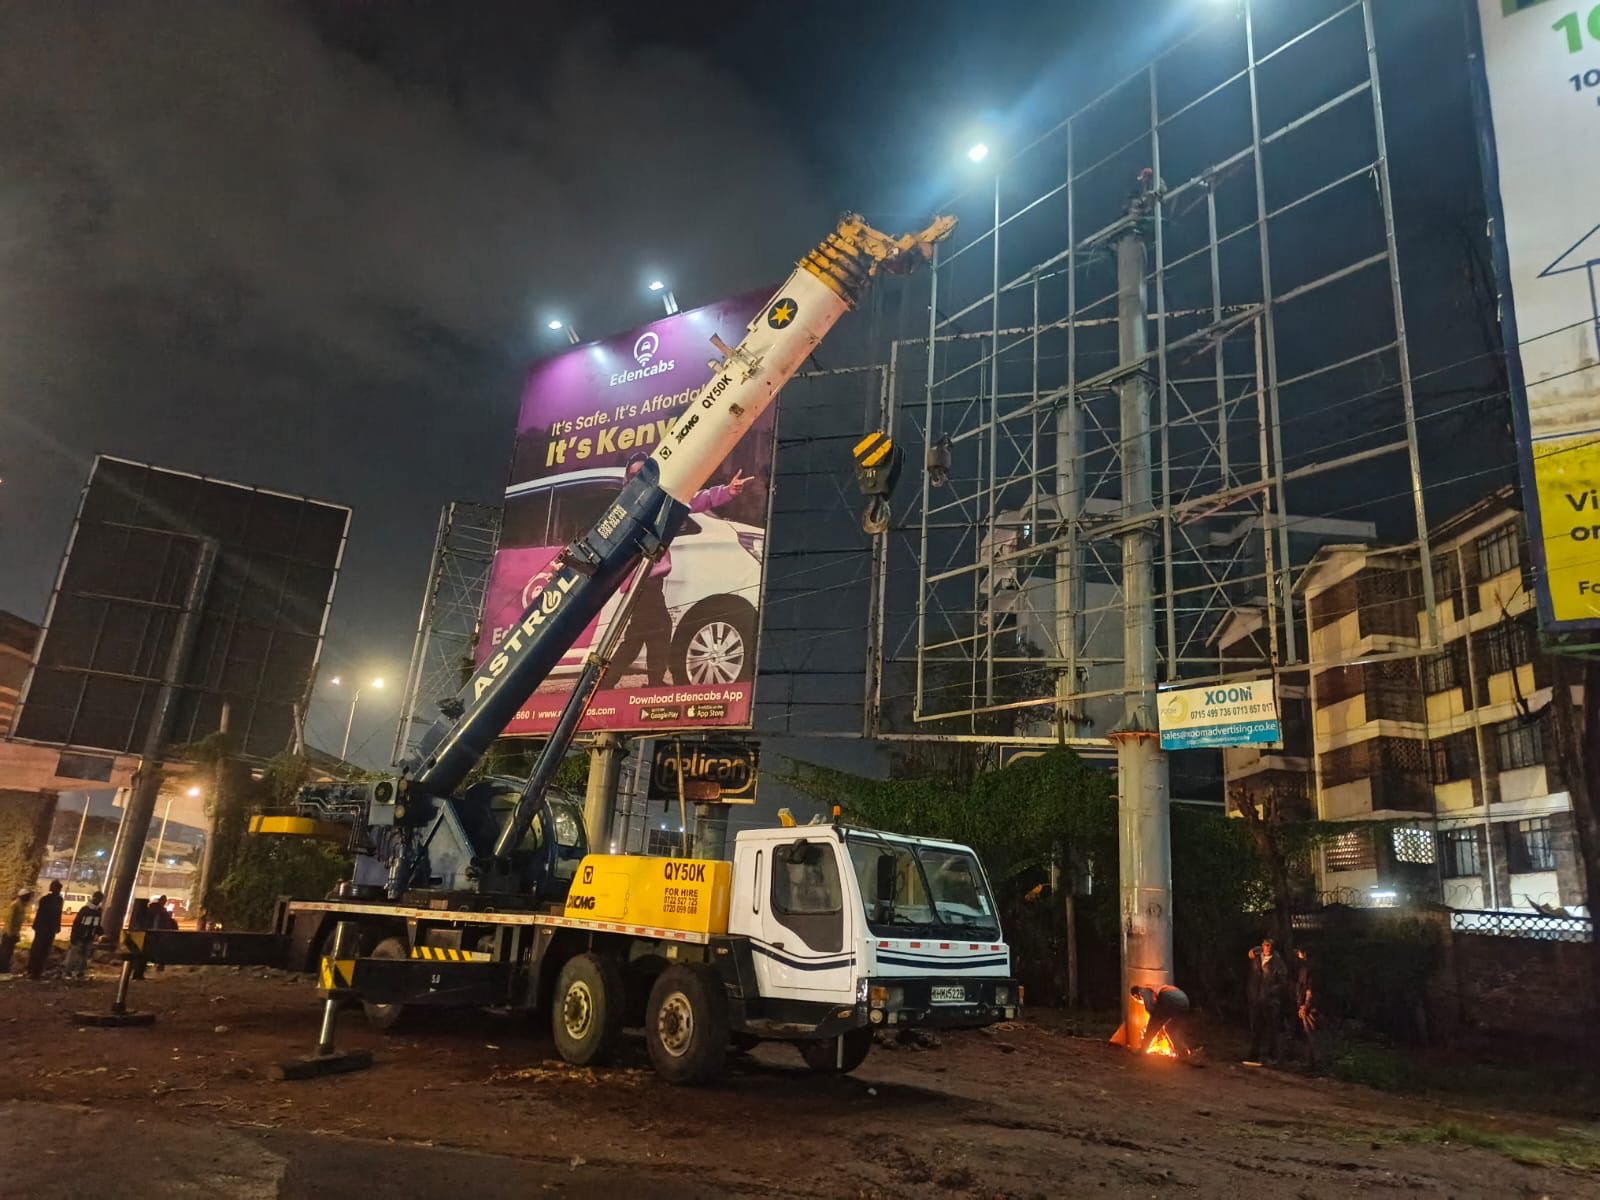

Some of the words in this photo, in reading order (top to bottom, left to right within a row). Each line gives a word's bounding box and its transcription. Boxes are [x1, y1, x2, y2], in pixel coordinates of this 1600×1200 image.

[609, 359, 675, 387] Edencabs
[702, 374, 733, 409] QY50K
[551, 420, 572, 437] It's
[575, 411, 611, 430] Safe.
[614, 404, 637, 420] It's
[676, 414, 700, 445] XCMG
[545, 434, 592, 467] It's
[596, 416, 678, 455] Keny
[472, 574, 579, 706] ASTROL
[629, 693, 674, 705] Download
[675, 691, 721, 703] Edencabs
[723, 690, 743, 702] App
[1205, 686, 1253, 706] XOOM
[697, 710, 708, 718] App
[1191, 709, 1206, 720] 0715
[1233, 705, 1248, 716] 0713
[664, 862, 705, 883] QY50K
[567, 895, 596, 910] XCMG
[665, 888, 679, 897] FOR
[680, 889, 699, 898] HIRE
